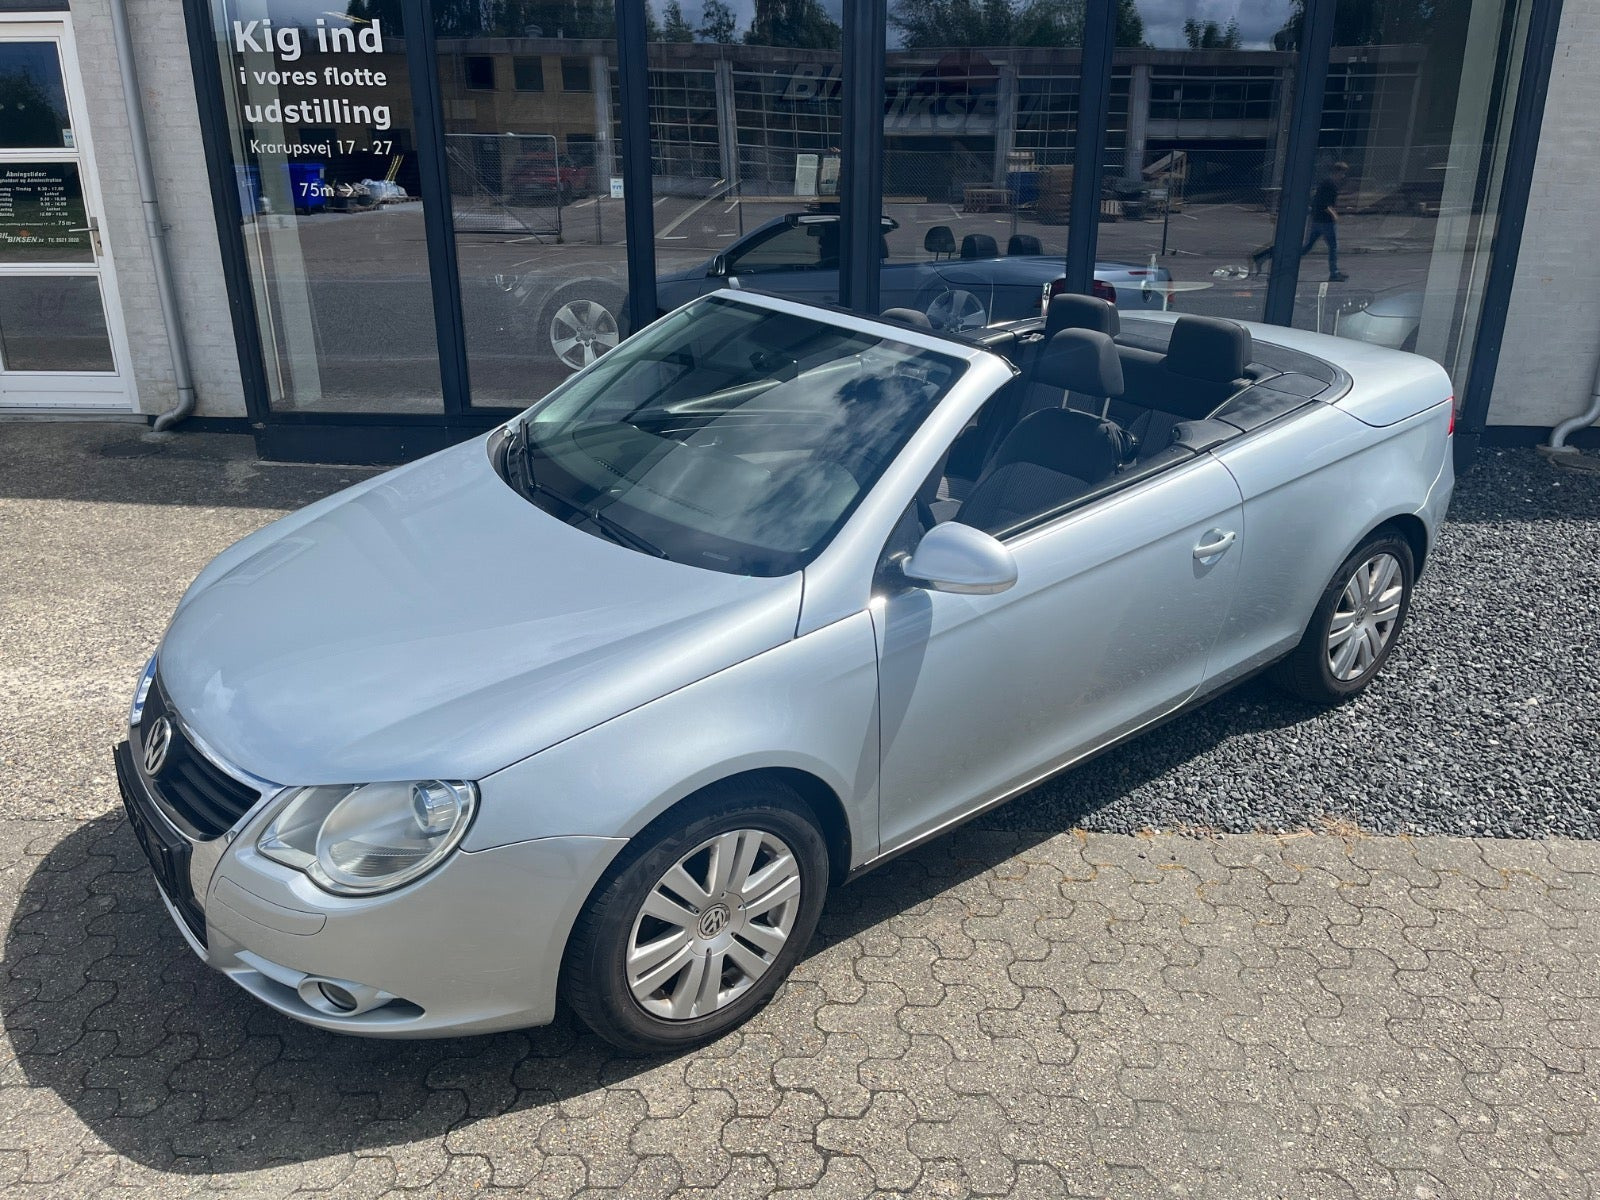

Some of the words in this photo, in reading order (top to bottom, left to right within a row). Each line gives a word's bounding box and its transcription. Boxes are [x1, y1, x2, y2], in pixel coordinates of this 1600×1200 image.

[233, 18, 302, 61] Kig
[316, 18, 384, 53] ind
[239, 67, 247, 85] i
[253, 70, 318, 86] vores
[324, 66, 387, 86] flotte
[244, 98, 392, 131] udstilling
[250, 139, 332, 158] Krarupsvej
[336, 140, 355, 155] 17
[372, 140, 393, 155] 27
[299, 182, 335, 197] 75m
